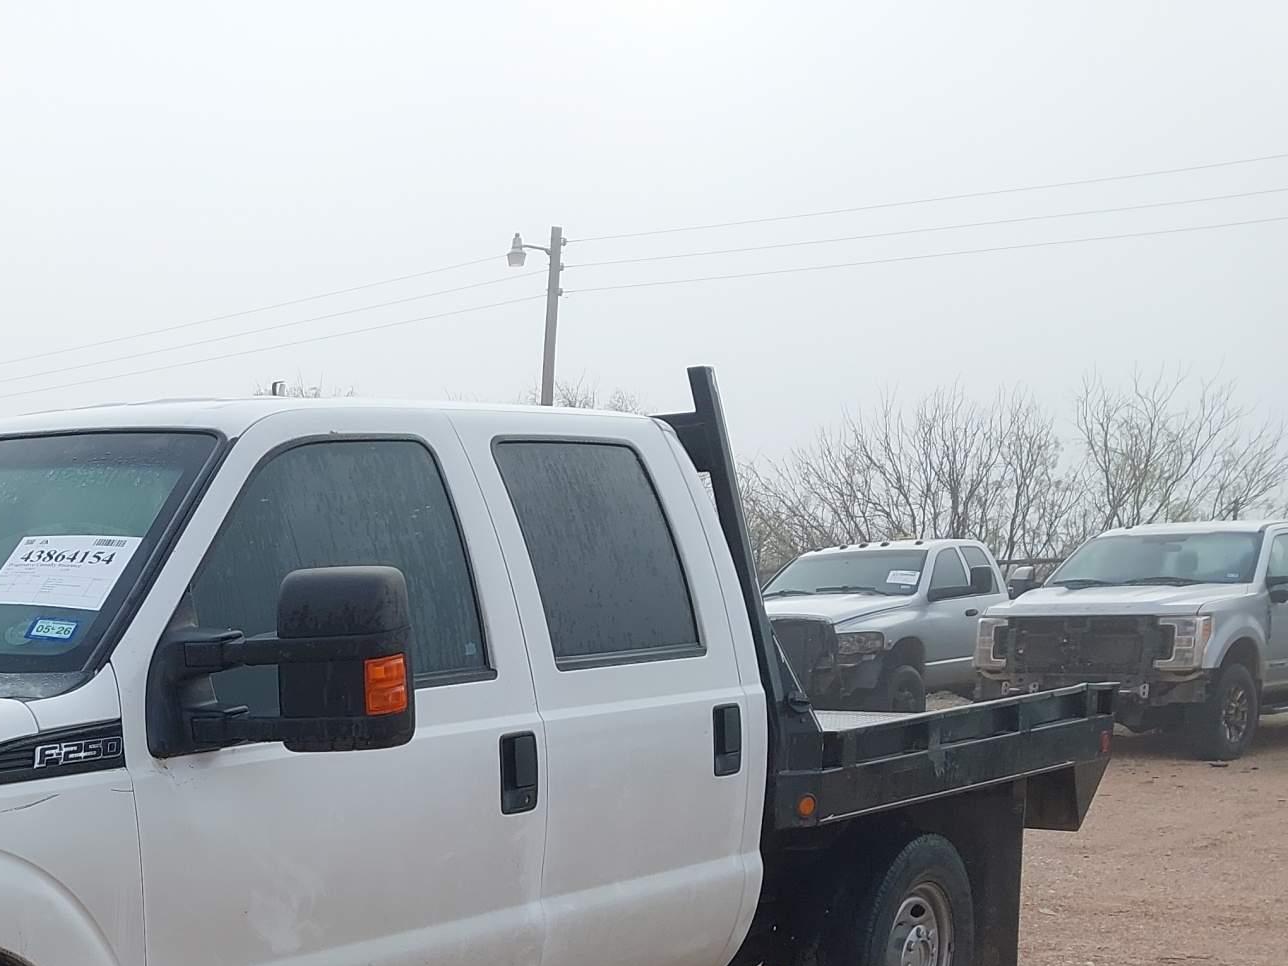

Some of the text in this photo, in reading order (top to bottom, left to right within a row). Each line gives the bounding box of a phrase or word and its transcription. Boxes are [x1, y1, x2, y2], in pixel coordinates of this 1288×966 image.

[20, 549, 116, 565] 43864154
[35, 624, 73, 635] 05 26
